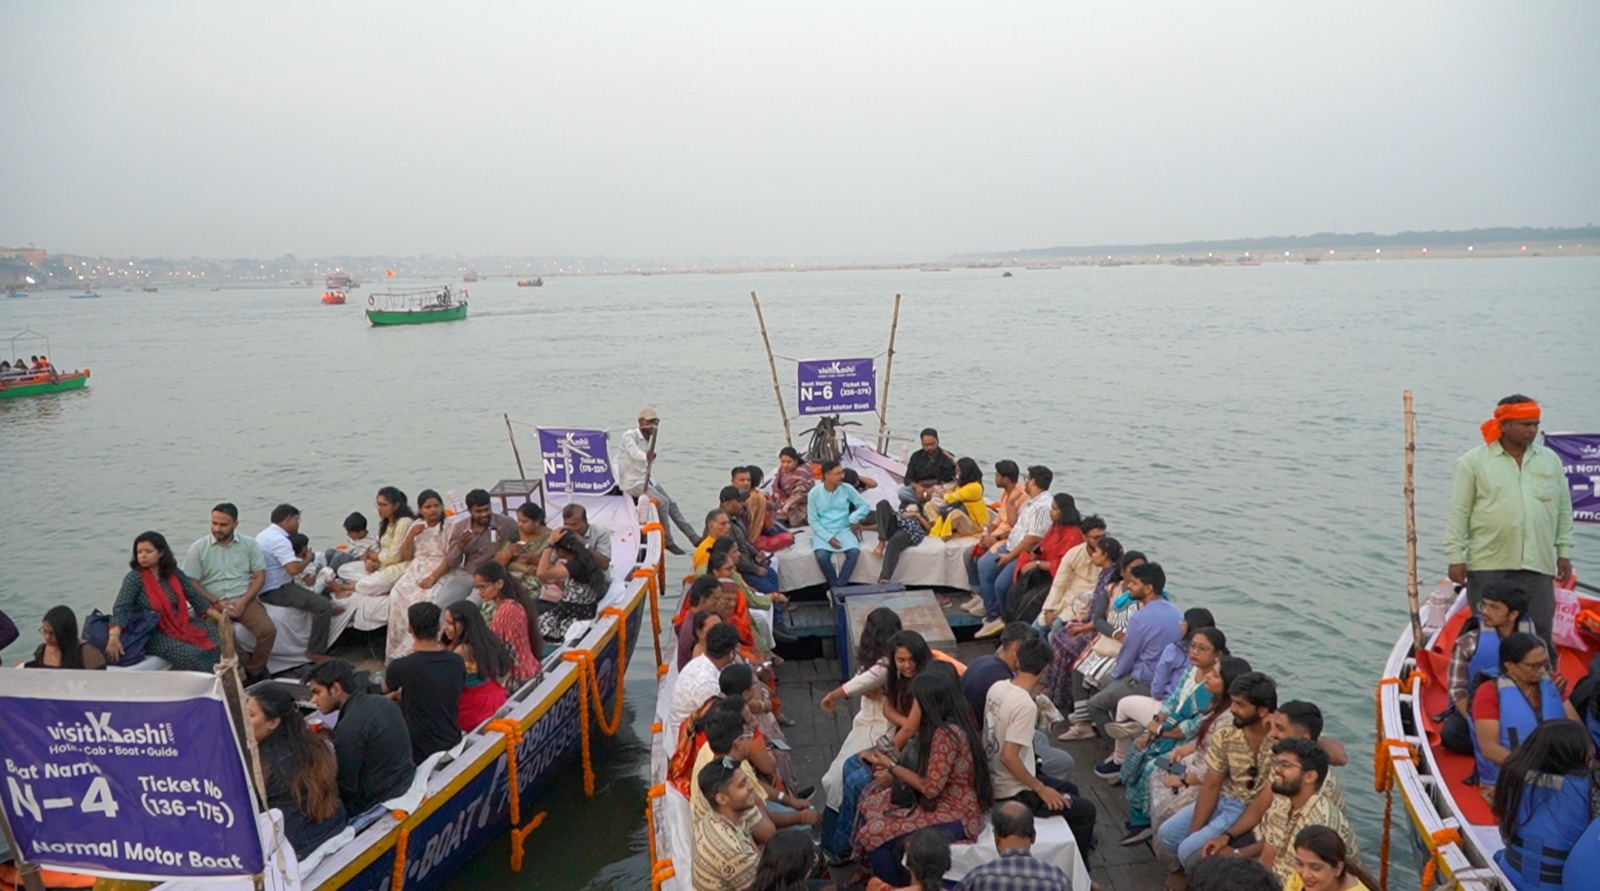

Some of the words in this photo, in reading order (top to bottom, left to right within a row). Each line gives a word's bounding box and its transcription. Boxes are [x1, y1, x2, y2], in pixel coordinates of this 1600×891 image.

[801, 385, 833, 401] N-6
[575, 481, 592, 489] Motor
[593, 480, 611, 490] Boat
[84, 745, 106, 756] Cab
[115, 745, 139, 756] Boat
[147, 747, 179, 757] Guide
[6, 776, 119, 822] N-4
[138, 776, 201, 793] Ticket
[204, 778, 222, 800] No
[140, 792, 235, 829] (136-175)
[32, 839, 118, 859] Normal
[125, 841, 183, 867] Motor
[188, 851, 243, 870] Boat
